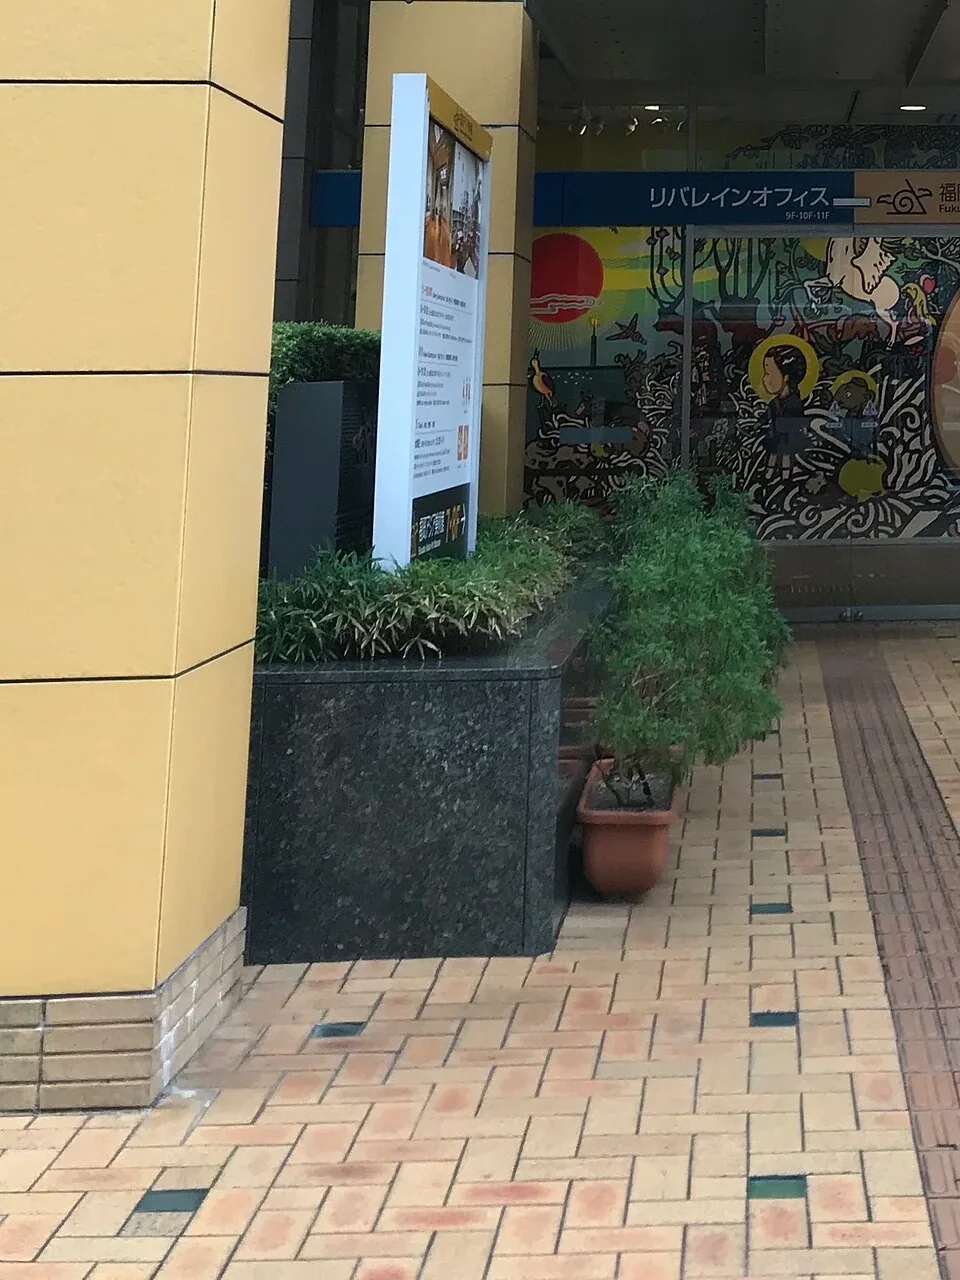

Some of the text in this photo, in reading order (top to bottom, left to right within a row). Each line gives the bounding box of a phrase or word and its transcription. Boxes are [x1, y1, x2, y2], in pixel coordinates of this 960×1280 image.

[649, 186, 830, 208] リバレインオフィス
